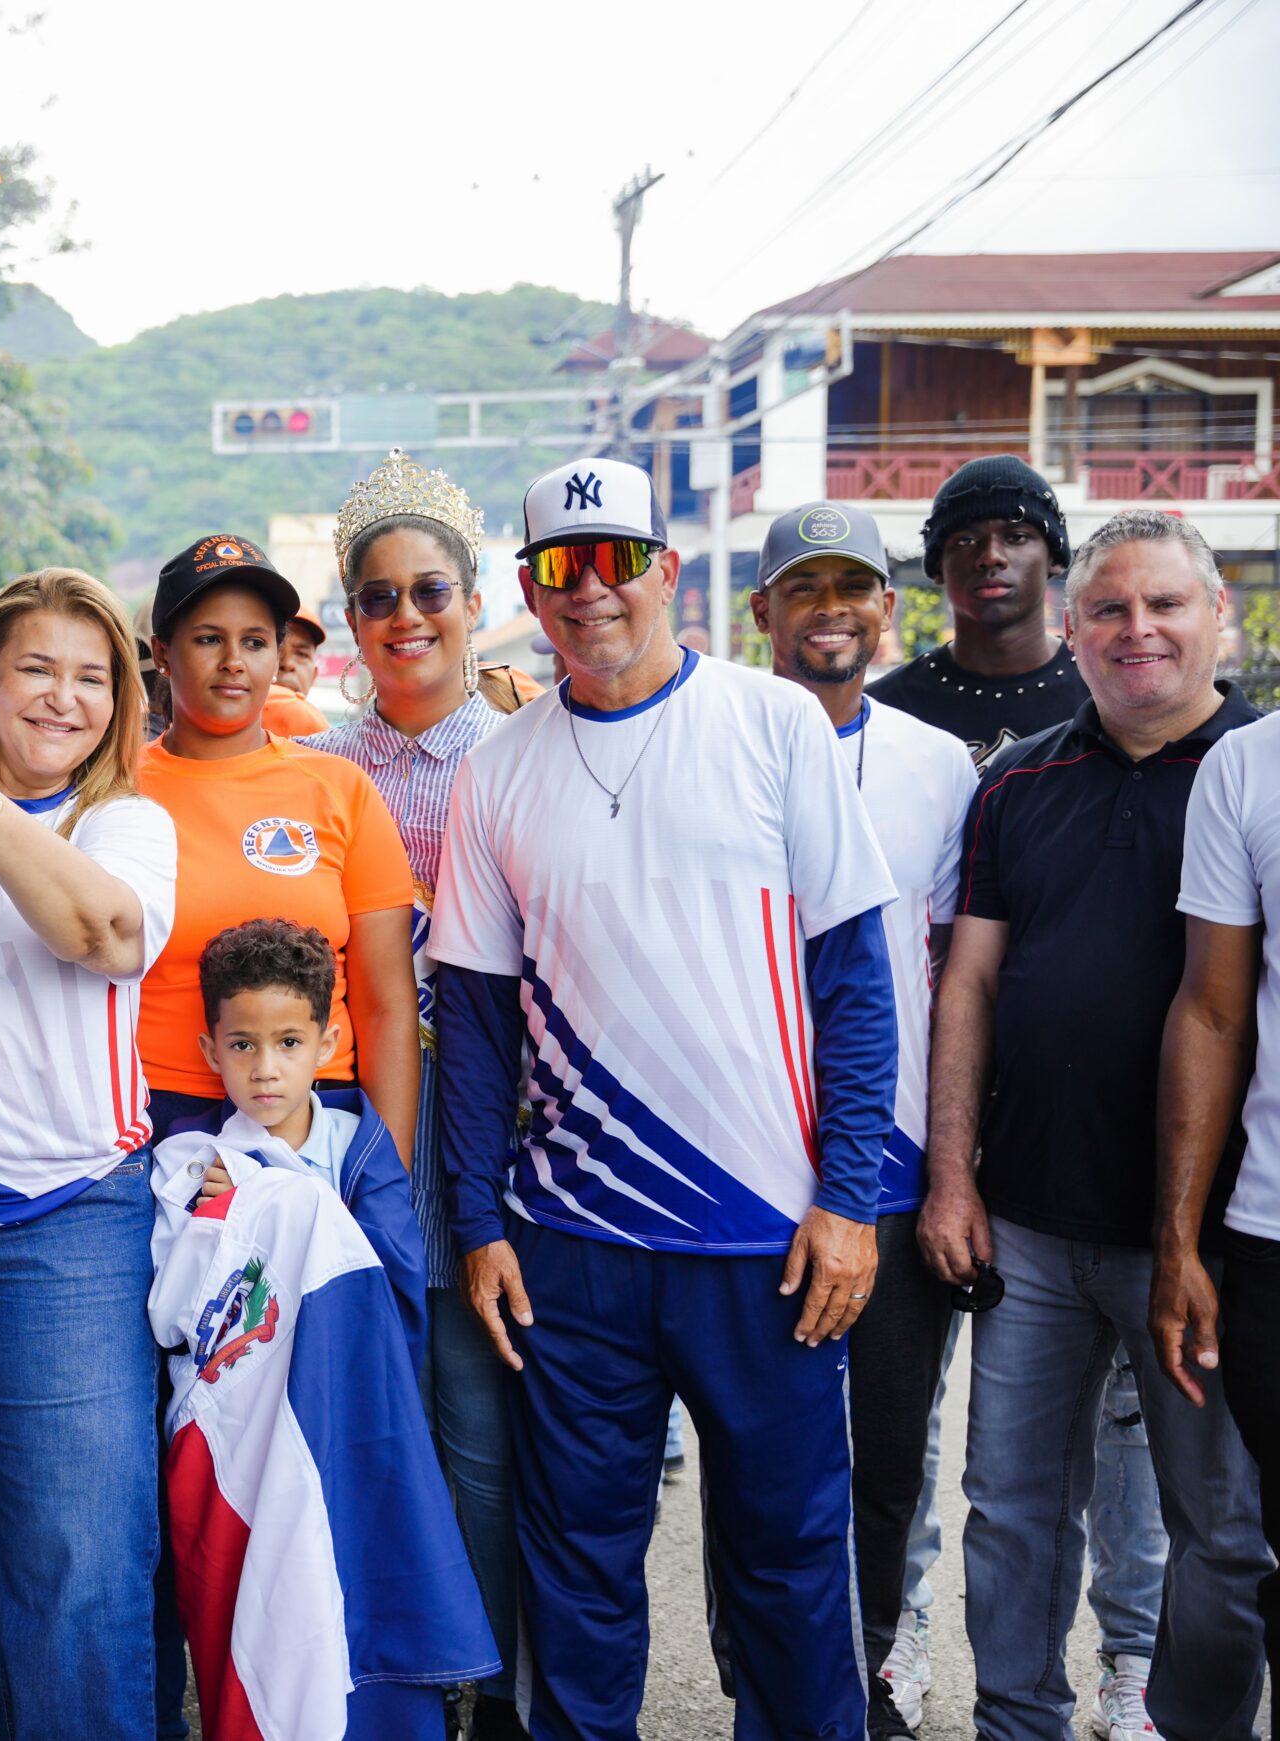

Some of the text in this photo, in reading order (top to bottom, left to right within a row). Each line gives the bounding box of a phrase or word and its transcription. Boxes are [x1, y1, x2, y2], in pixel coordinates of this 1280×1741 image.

[564, 471, 603, 511] NY
[193, 535, 263, 562] DEFENSA CIVIL
[809, 528, 837, 538] 365
[244, 819, 318, 857] DEFENSA CIVIL
[200, 1305, 215, 1331] PATRIA
[219, 1272, 244, 1302] LIBERTAD
